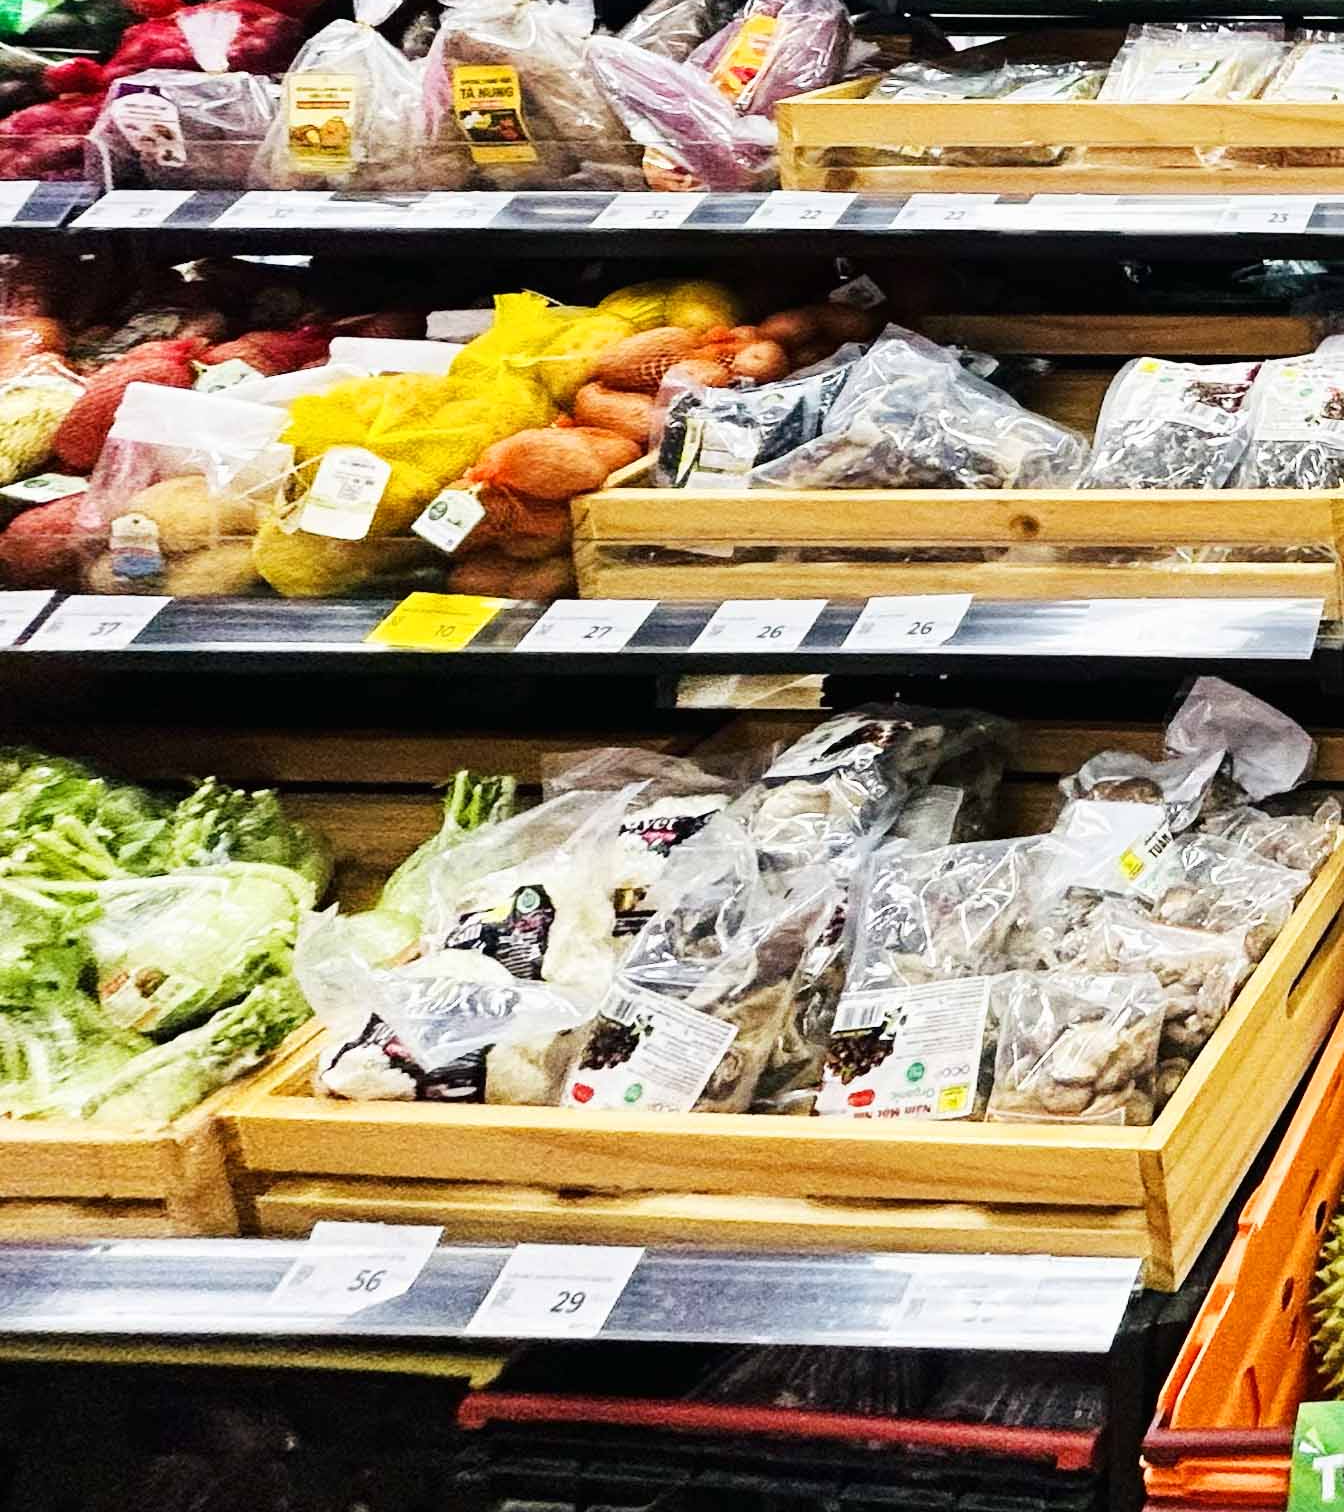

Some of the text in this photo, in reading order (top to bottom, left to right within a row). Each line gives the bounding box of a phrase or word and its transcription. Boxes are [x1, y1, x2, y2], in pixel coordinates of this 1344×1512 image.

[88, 621, 122, 636] 37
[584, 625, 613, 638] 27
[756, 625, 785, 639] 26
[907, 621, 935, 635] 26
[347, 1269, 387, 1292] 56
[549, 1290, 587, 1314] 29
